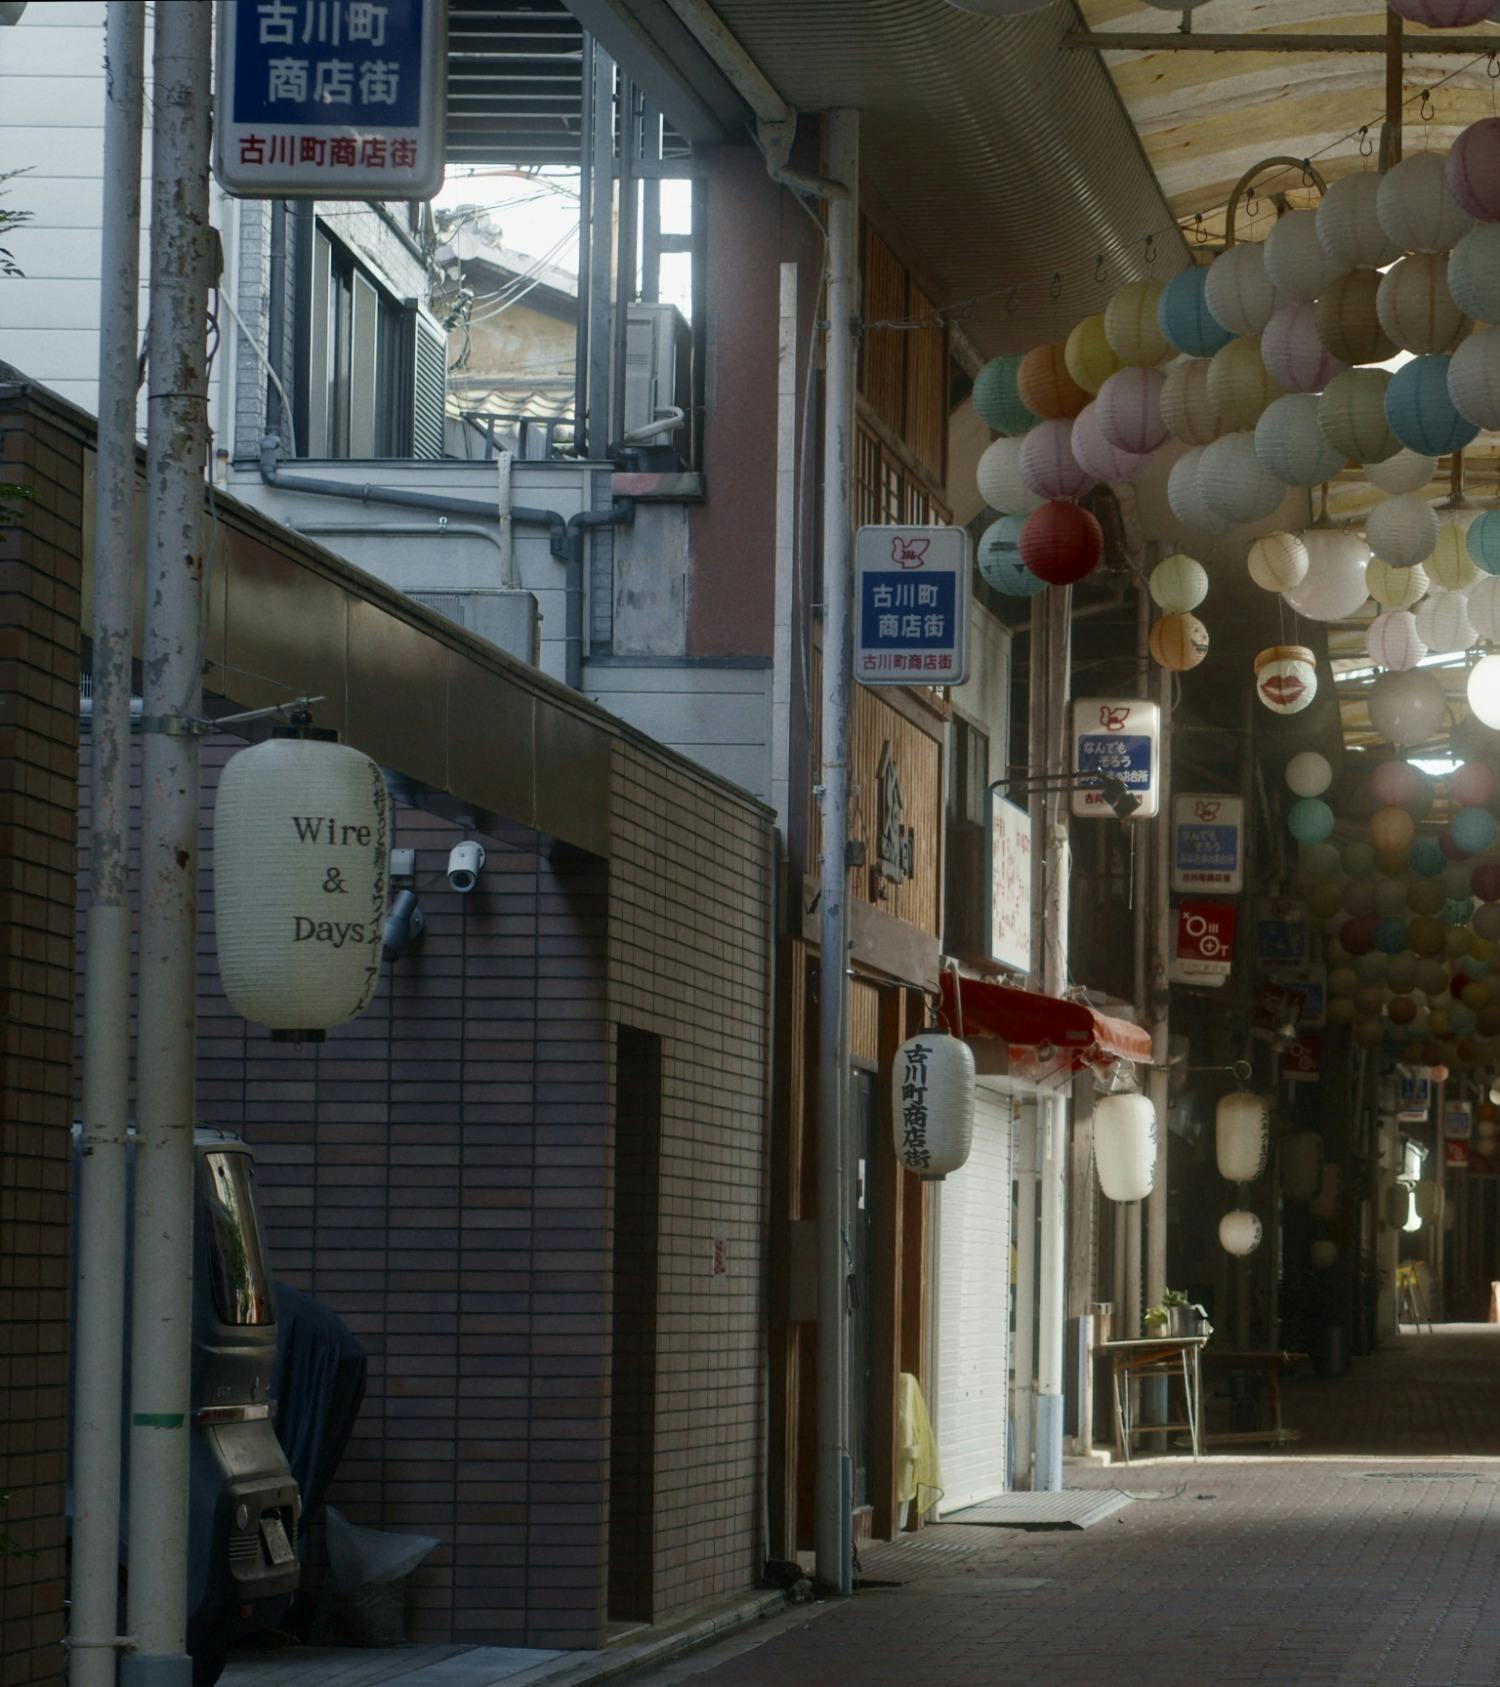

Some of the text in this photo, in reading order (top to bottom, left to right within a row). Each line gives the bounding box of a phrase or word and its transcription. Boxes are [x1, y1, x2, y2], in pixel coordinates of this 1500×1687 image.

[257, 0, 388, 47] 古川町
[267, 57, 400, 105] 商店街
[239, 133, 417, 168] 古川町商店街
[873, 584, 938, 608] 古川町
[879, 614, 945, 639] 商店街
[864, 654, 953, 671] 古川町商店街
[1083, 741, 1127, 755] なんでも
[1099, 755, 1132, 768] そろう
[293, 816, 371, 846] Wire
[322, 867, 348, 893] &
[293, 916, 364, 948] Days
[903, 1043, 933, 1169] 古川町商店街
